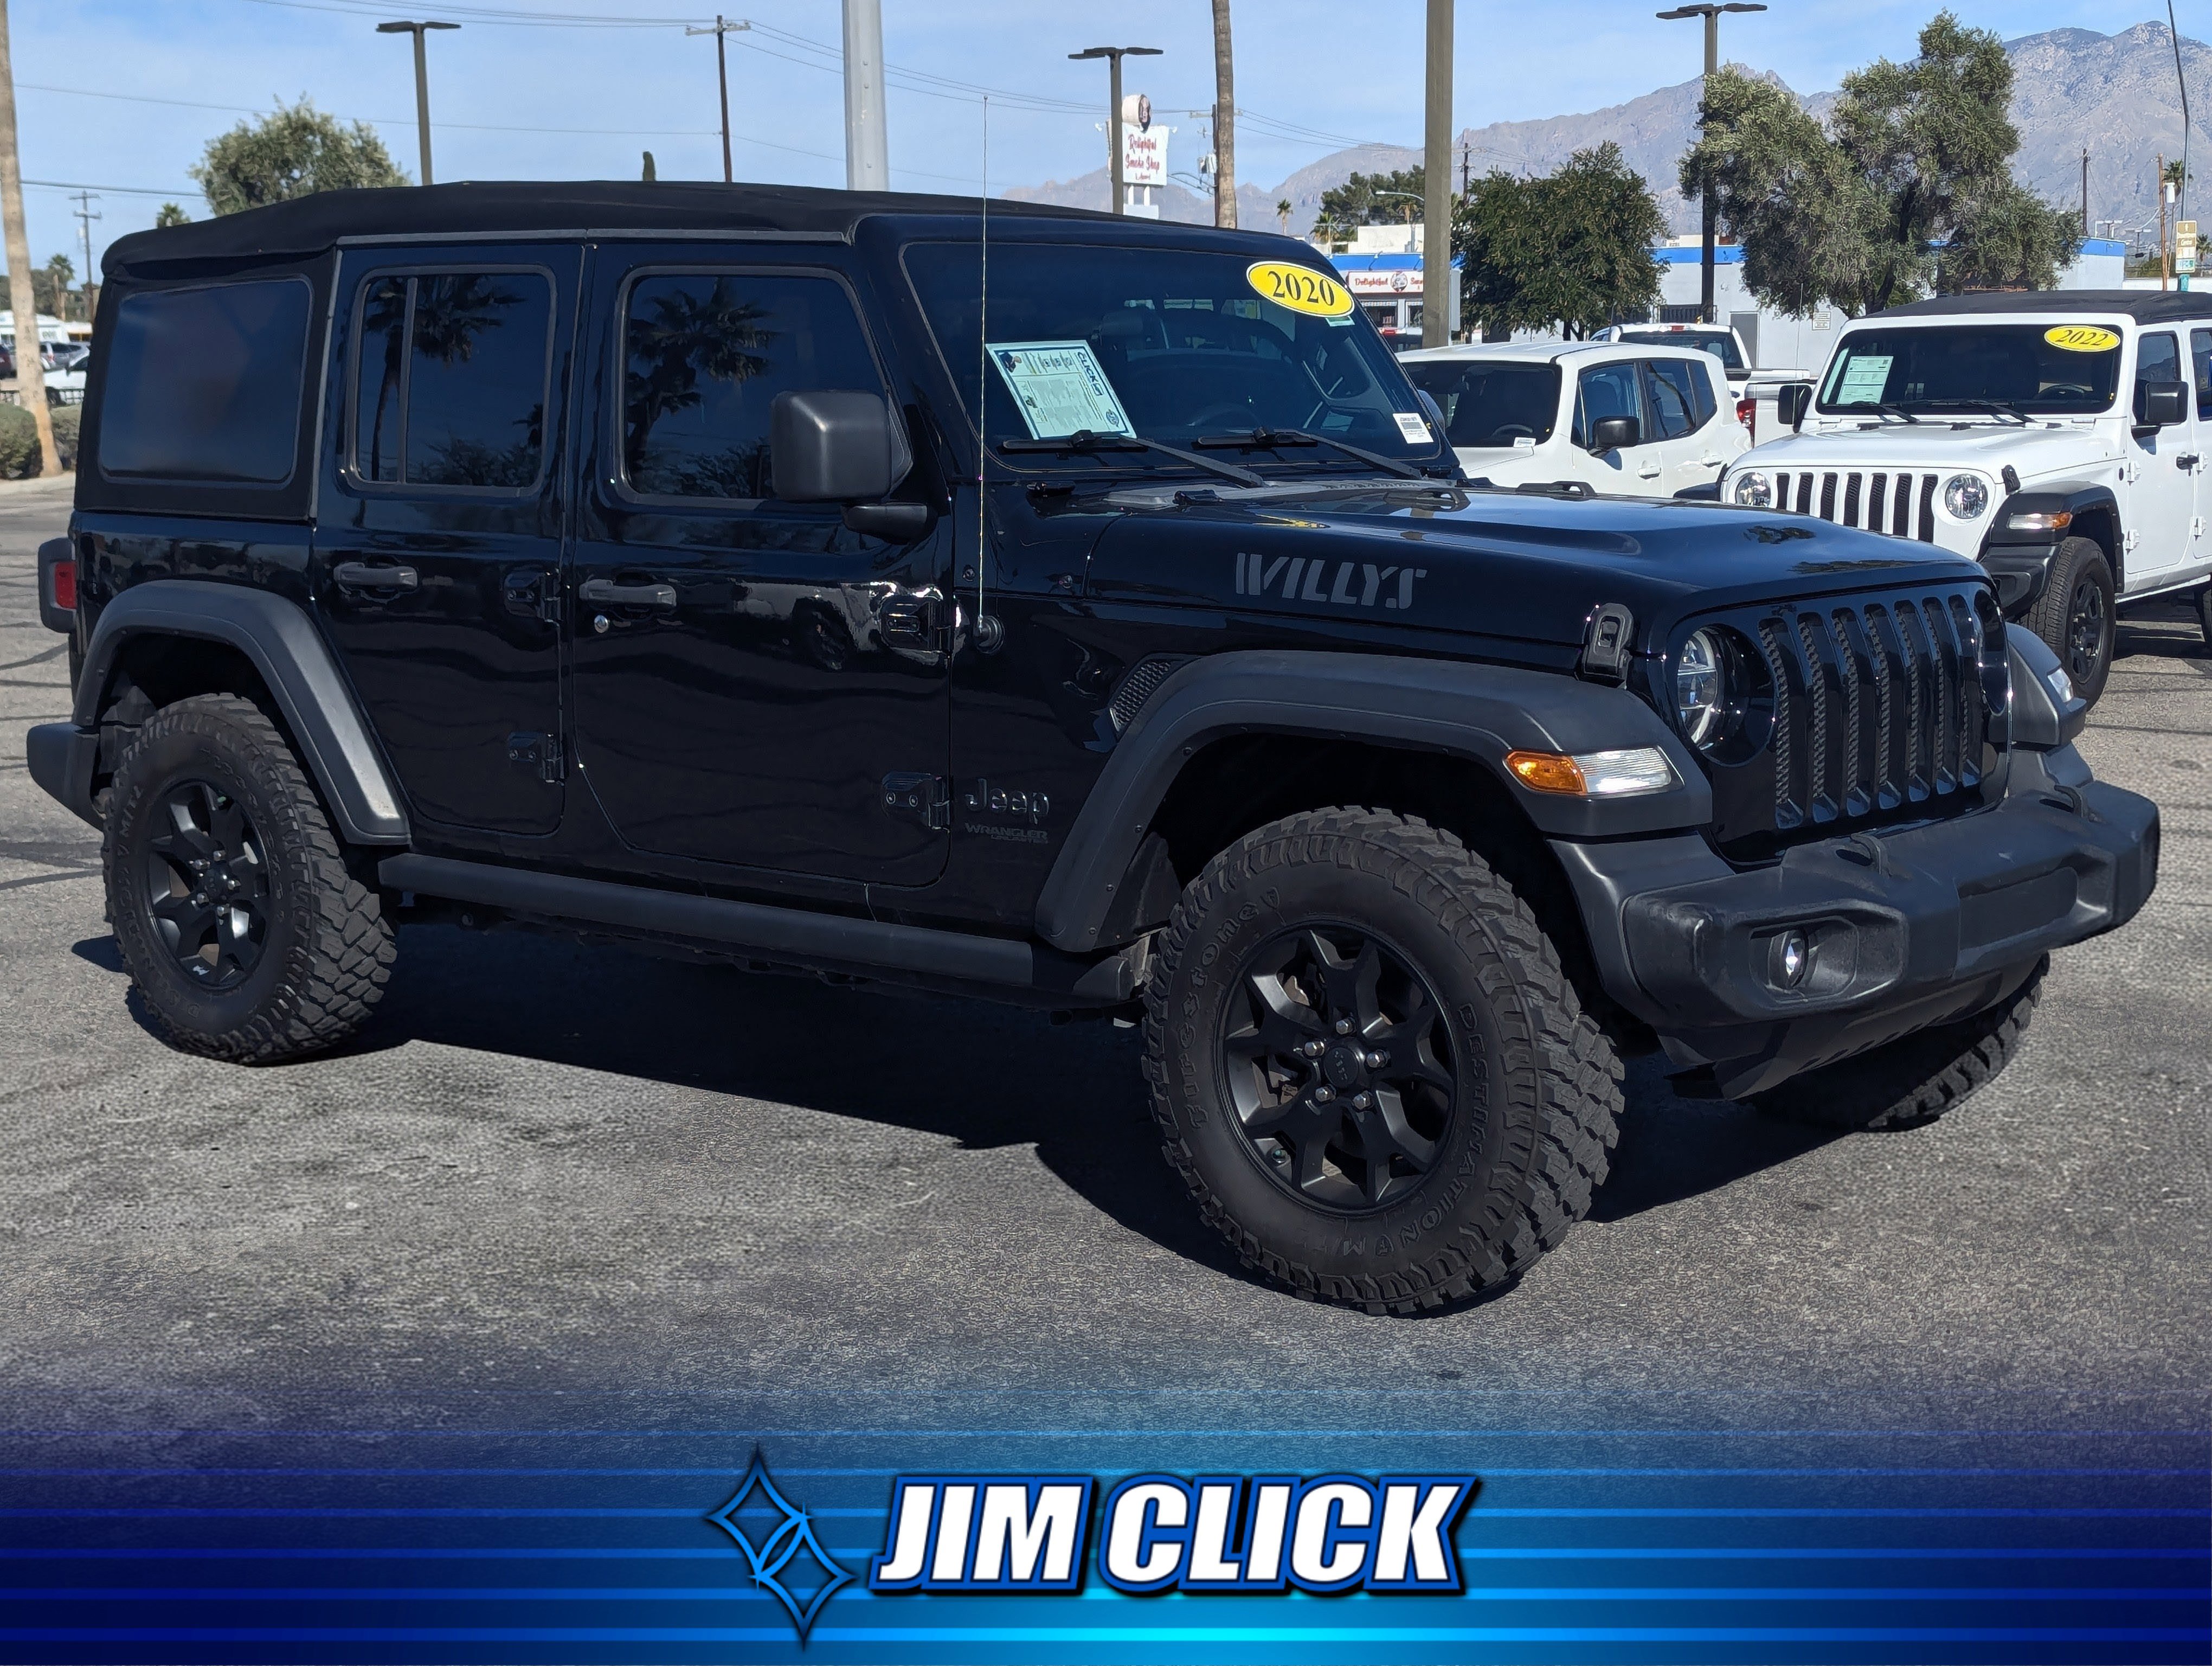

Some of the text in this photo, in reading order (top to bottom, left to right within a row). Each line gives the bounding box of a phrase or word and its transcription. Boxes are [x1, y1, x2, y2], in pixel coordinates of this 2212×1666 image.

[1268, 271, 1335, 306] 2020
[2055, 329, 2110, 346] 2022
[1236, 552, 1428, 610] WILLYS
[964, 778, 1050, 825] Jeep
[964, 822, 1048, 840] WRANGLER
